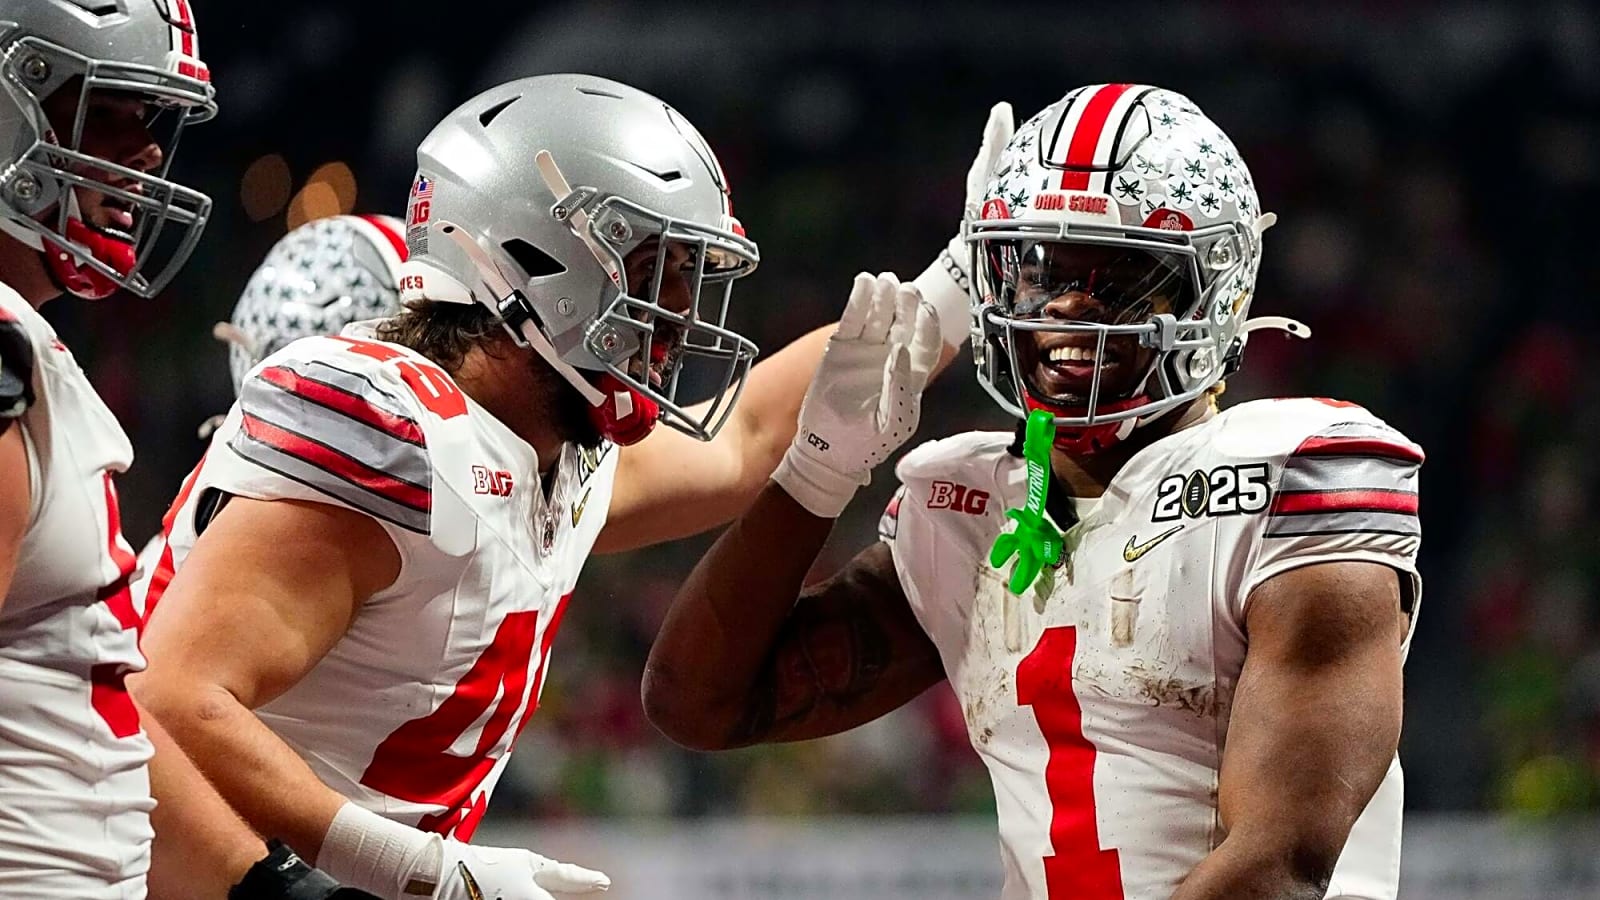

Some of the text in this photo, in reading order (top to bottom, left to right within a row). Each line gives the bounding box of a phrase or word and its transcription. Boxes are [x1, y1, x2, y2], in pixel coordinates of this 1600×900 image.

[1034, 194, 1109, 215] OHIO STATE
[807, 432, 830, 452] CFP
[1027, 459, 1045, 516] NXTRND
[1016, 625, 1124, 900] 1
